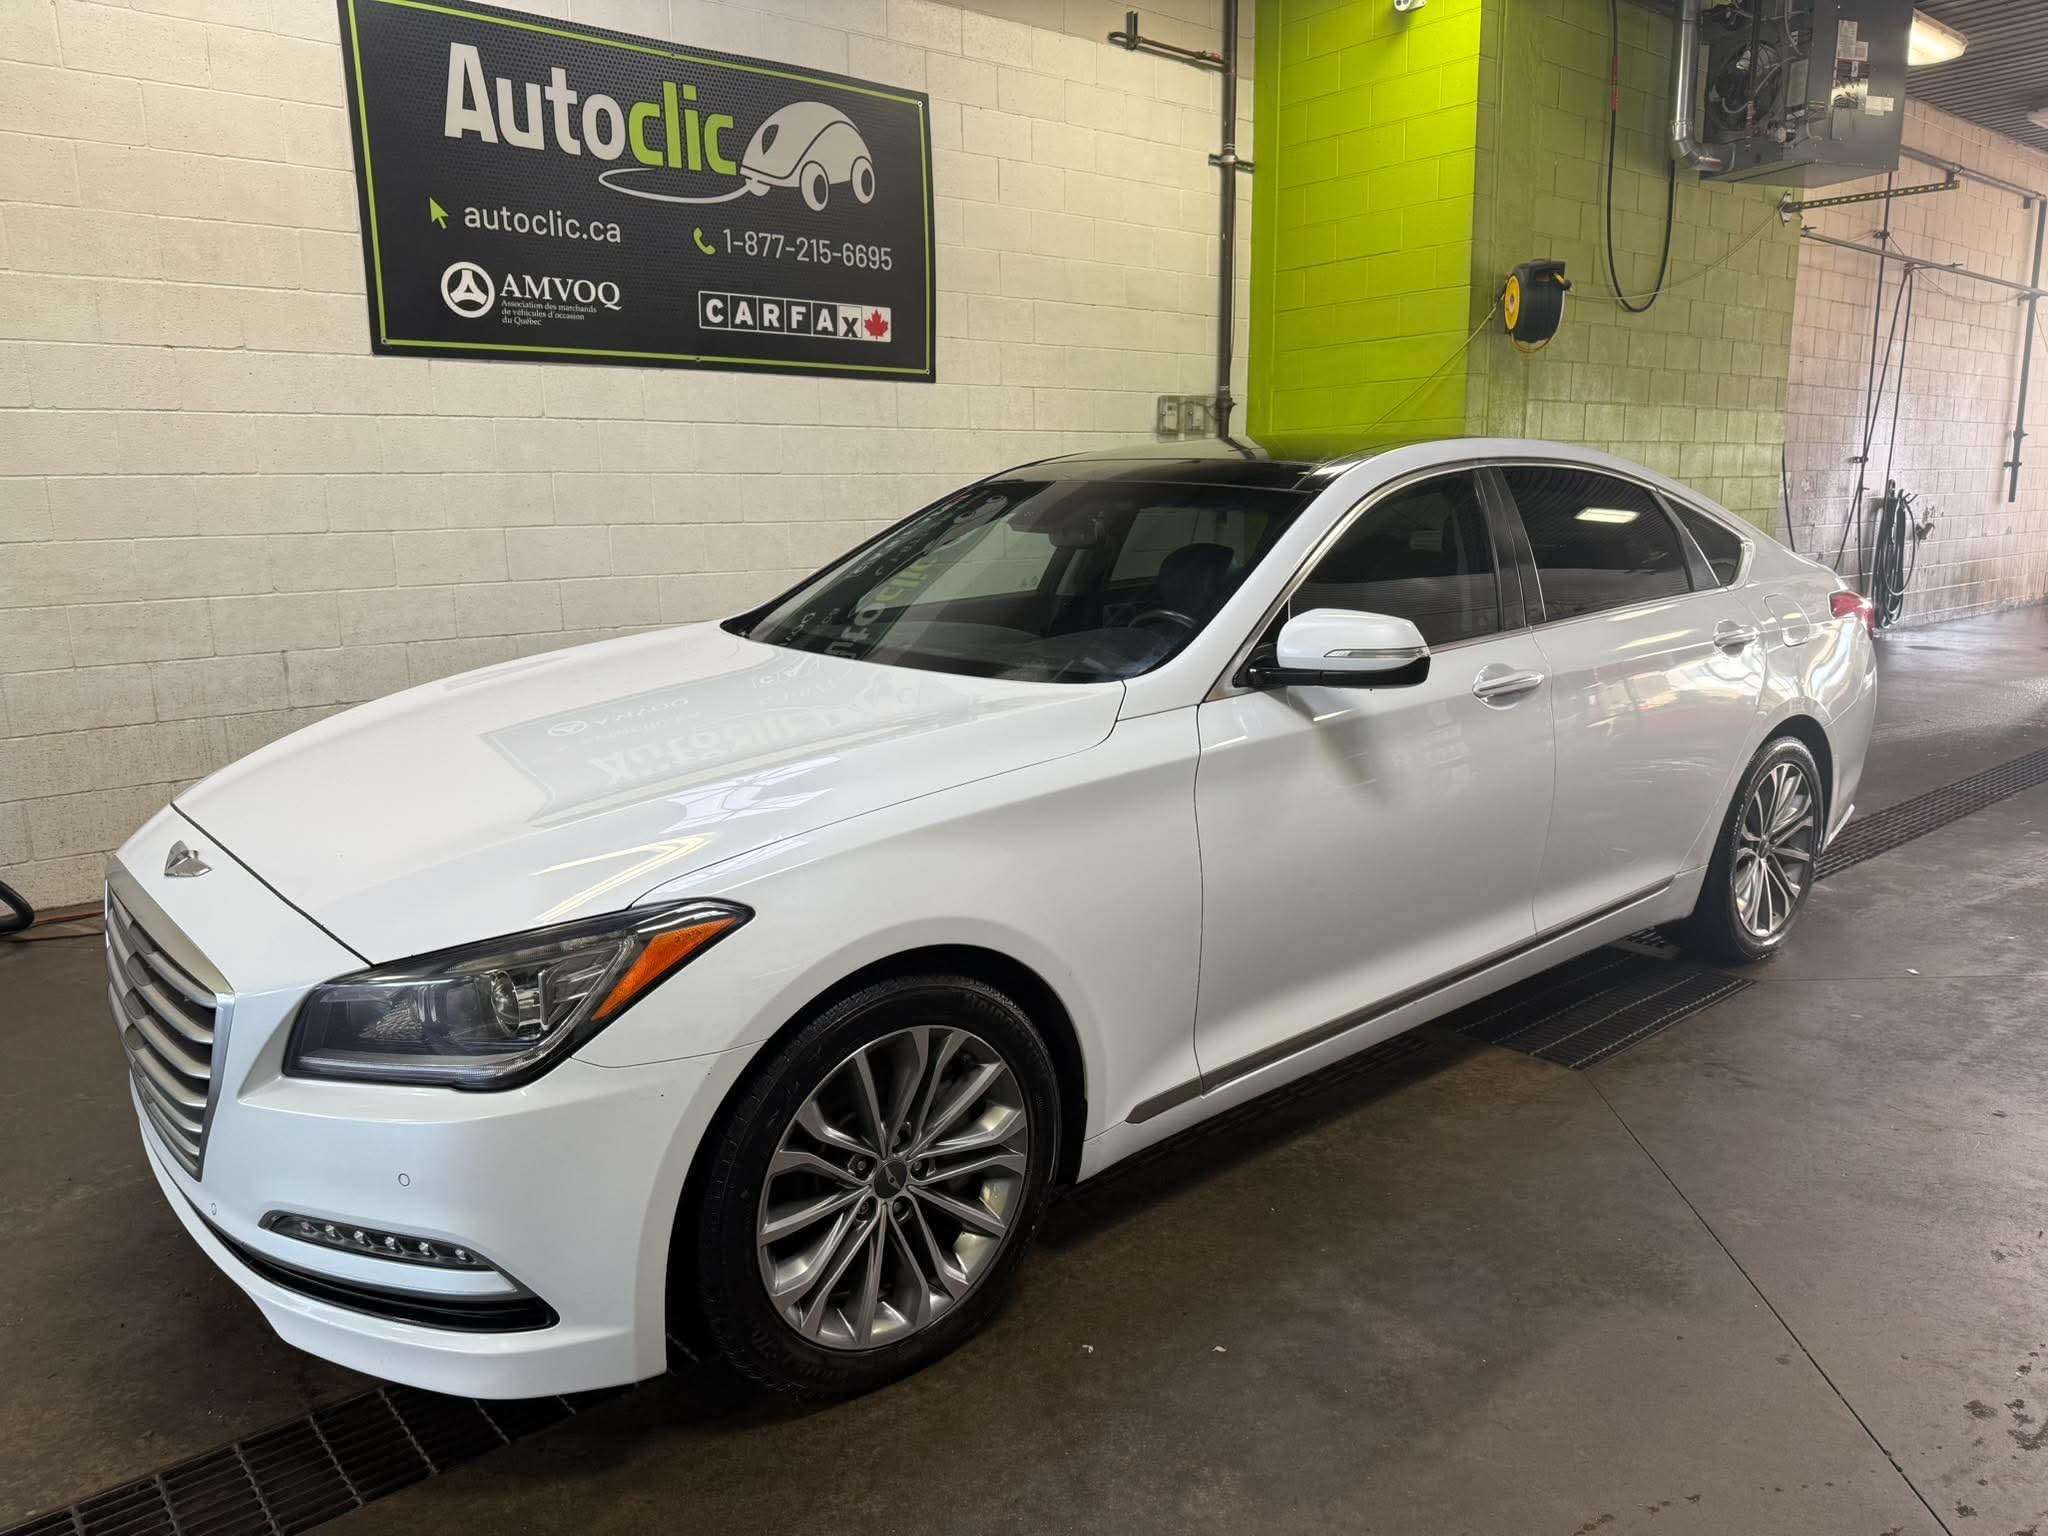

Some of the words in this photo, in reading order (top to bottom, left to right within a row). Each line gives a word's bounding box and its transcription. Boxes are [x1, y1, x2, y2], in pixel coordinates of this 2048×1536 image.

[444, 42, 737, 176] Autoclic
[463, 205, 622, 244] autoclic.ca
[722, 228, 893, 271] 1-877-215-6695
[499, 273, 622, 311] AMVOQ
[501, 299, 543, 310] Association
[544, 303, 557, 311] des
[558, 304, 597, 313] marchands
[501, 308, 512, 316] de
[501, 315, 513, 324] du
[513, 316, 542, 326] Québec
[705, 298, 859, 338] CARFAX
